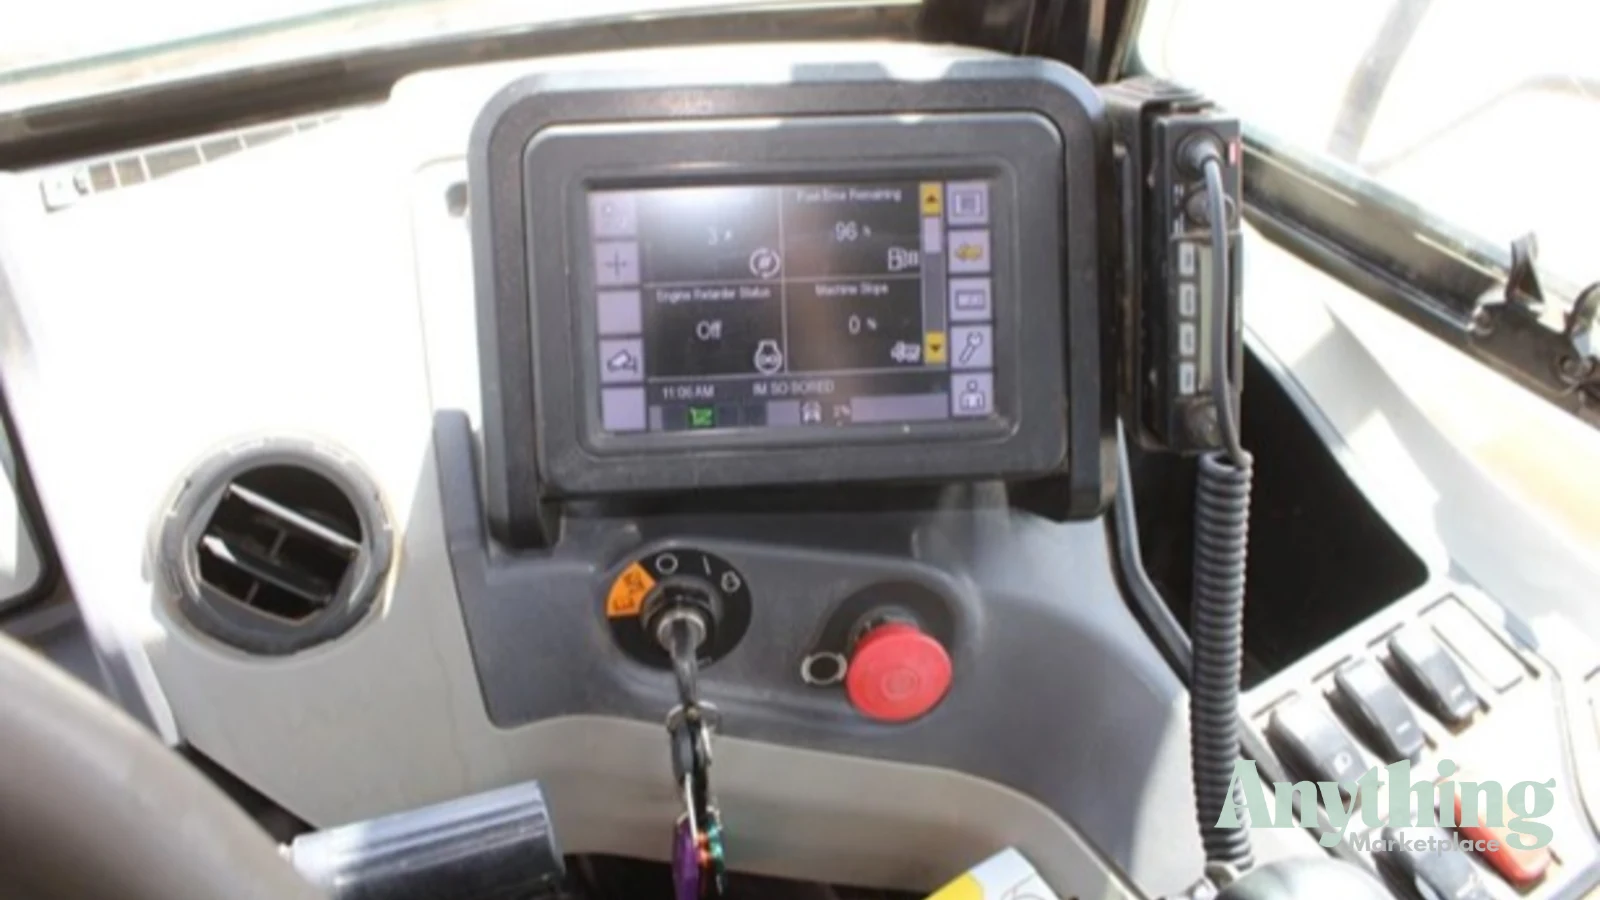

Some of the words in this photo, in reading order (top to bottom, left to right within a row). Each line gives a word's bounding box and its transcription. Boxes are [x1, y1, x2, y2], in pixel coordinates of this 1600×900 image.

[656, 288, 692, 305] Engine
[739, 285, 772, 300] Status
[815, 282, 858, 297] Machine
[696, 320, 723, 341] Off
